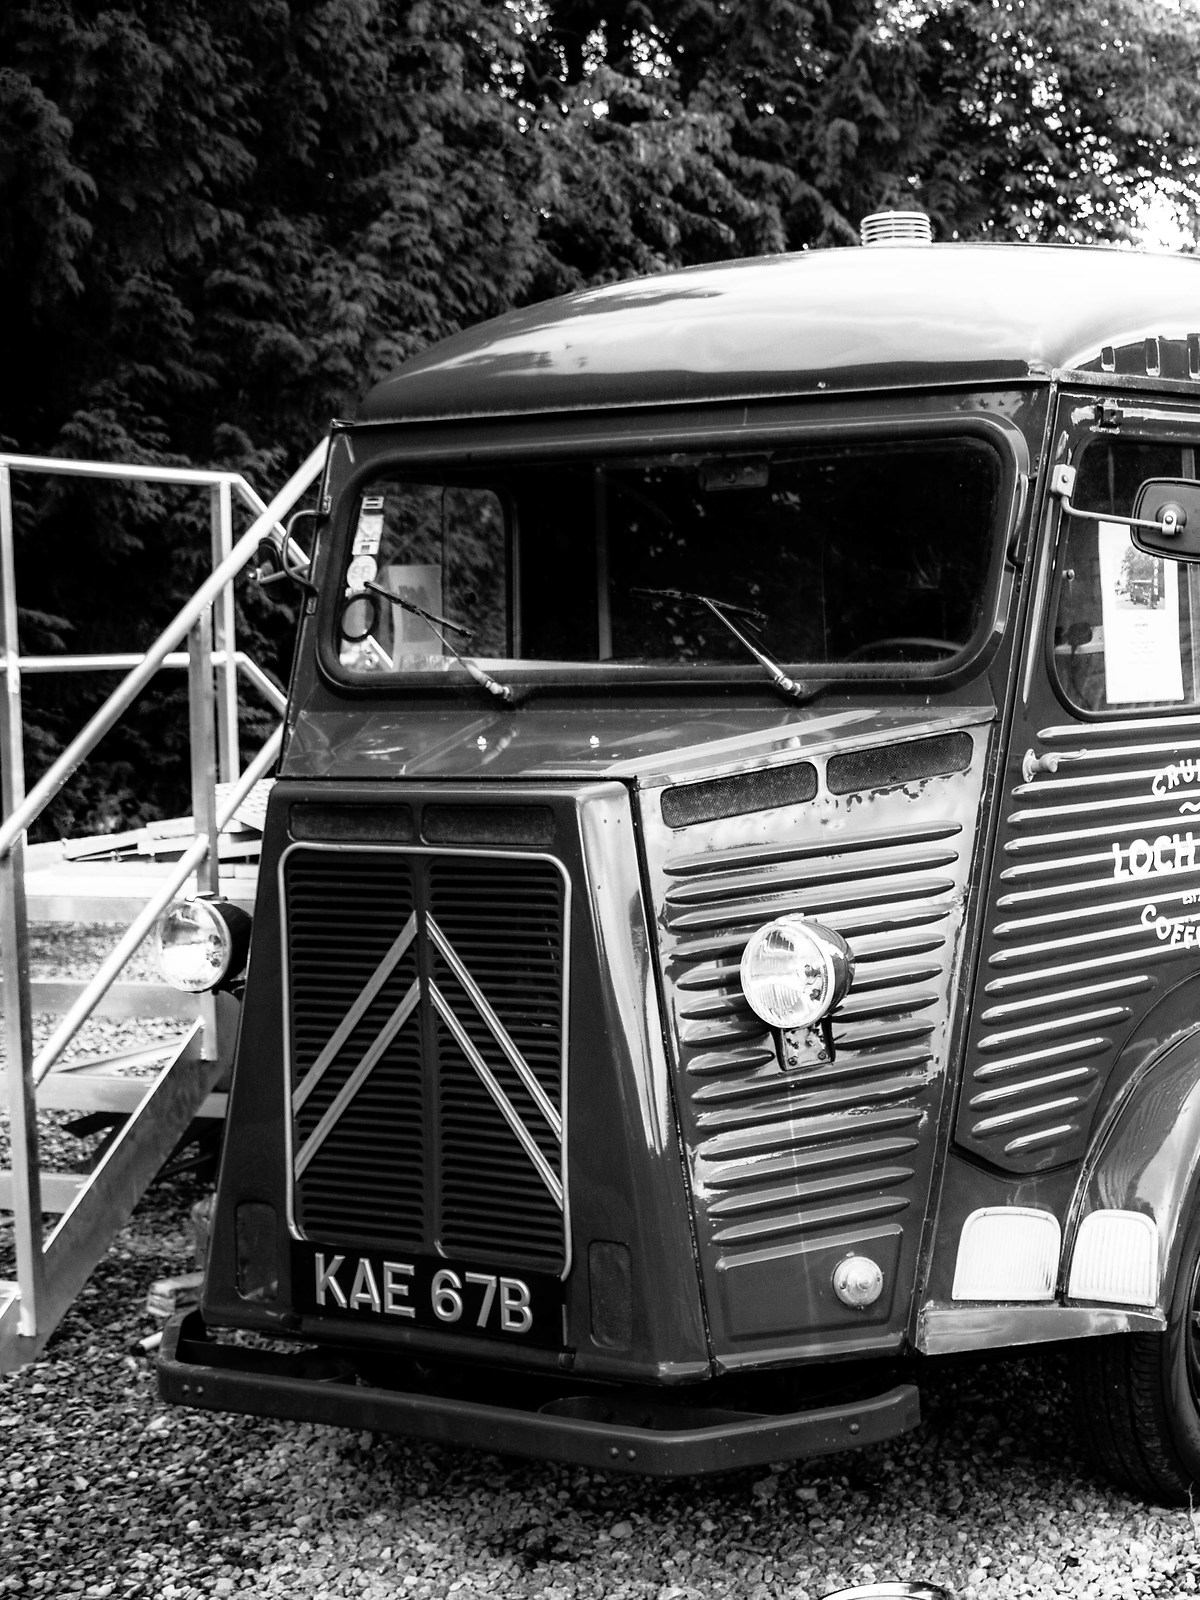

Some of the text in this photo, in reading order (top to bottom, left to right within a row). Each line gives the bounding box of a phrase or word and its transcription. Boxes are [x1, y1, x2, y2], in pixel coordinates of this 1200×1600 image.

[1112, 832, 1195, 880] LOCH
[314, 1252, 533, 1334] KAE 67B
